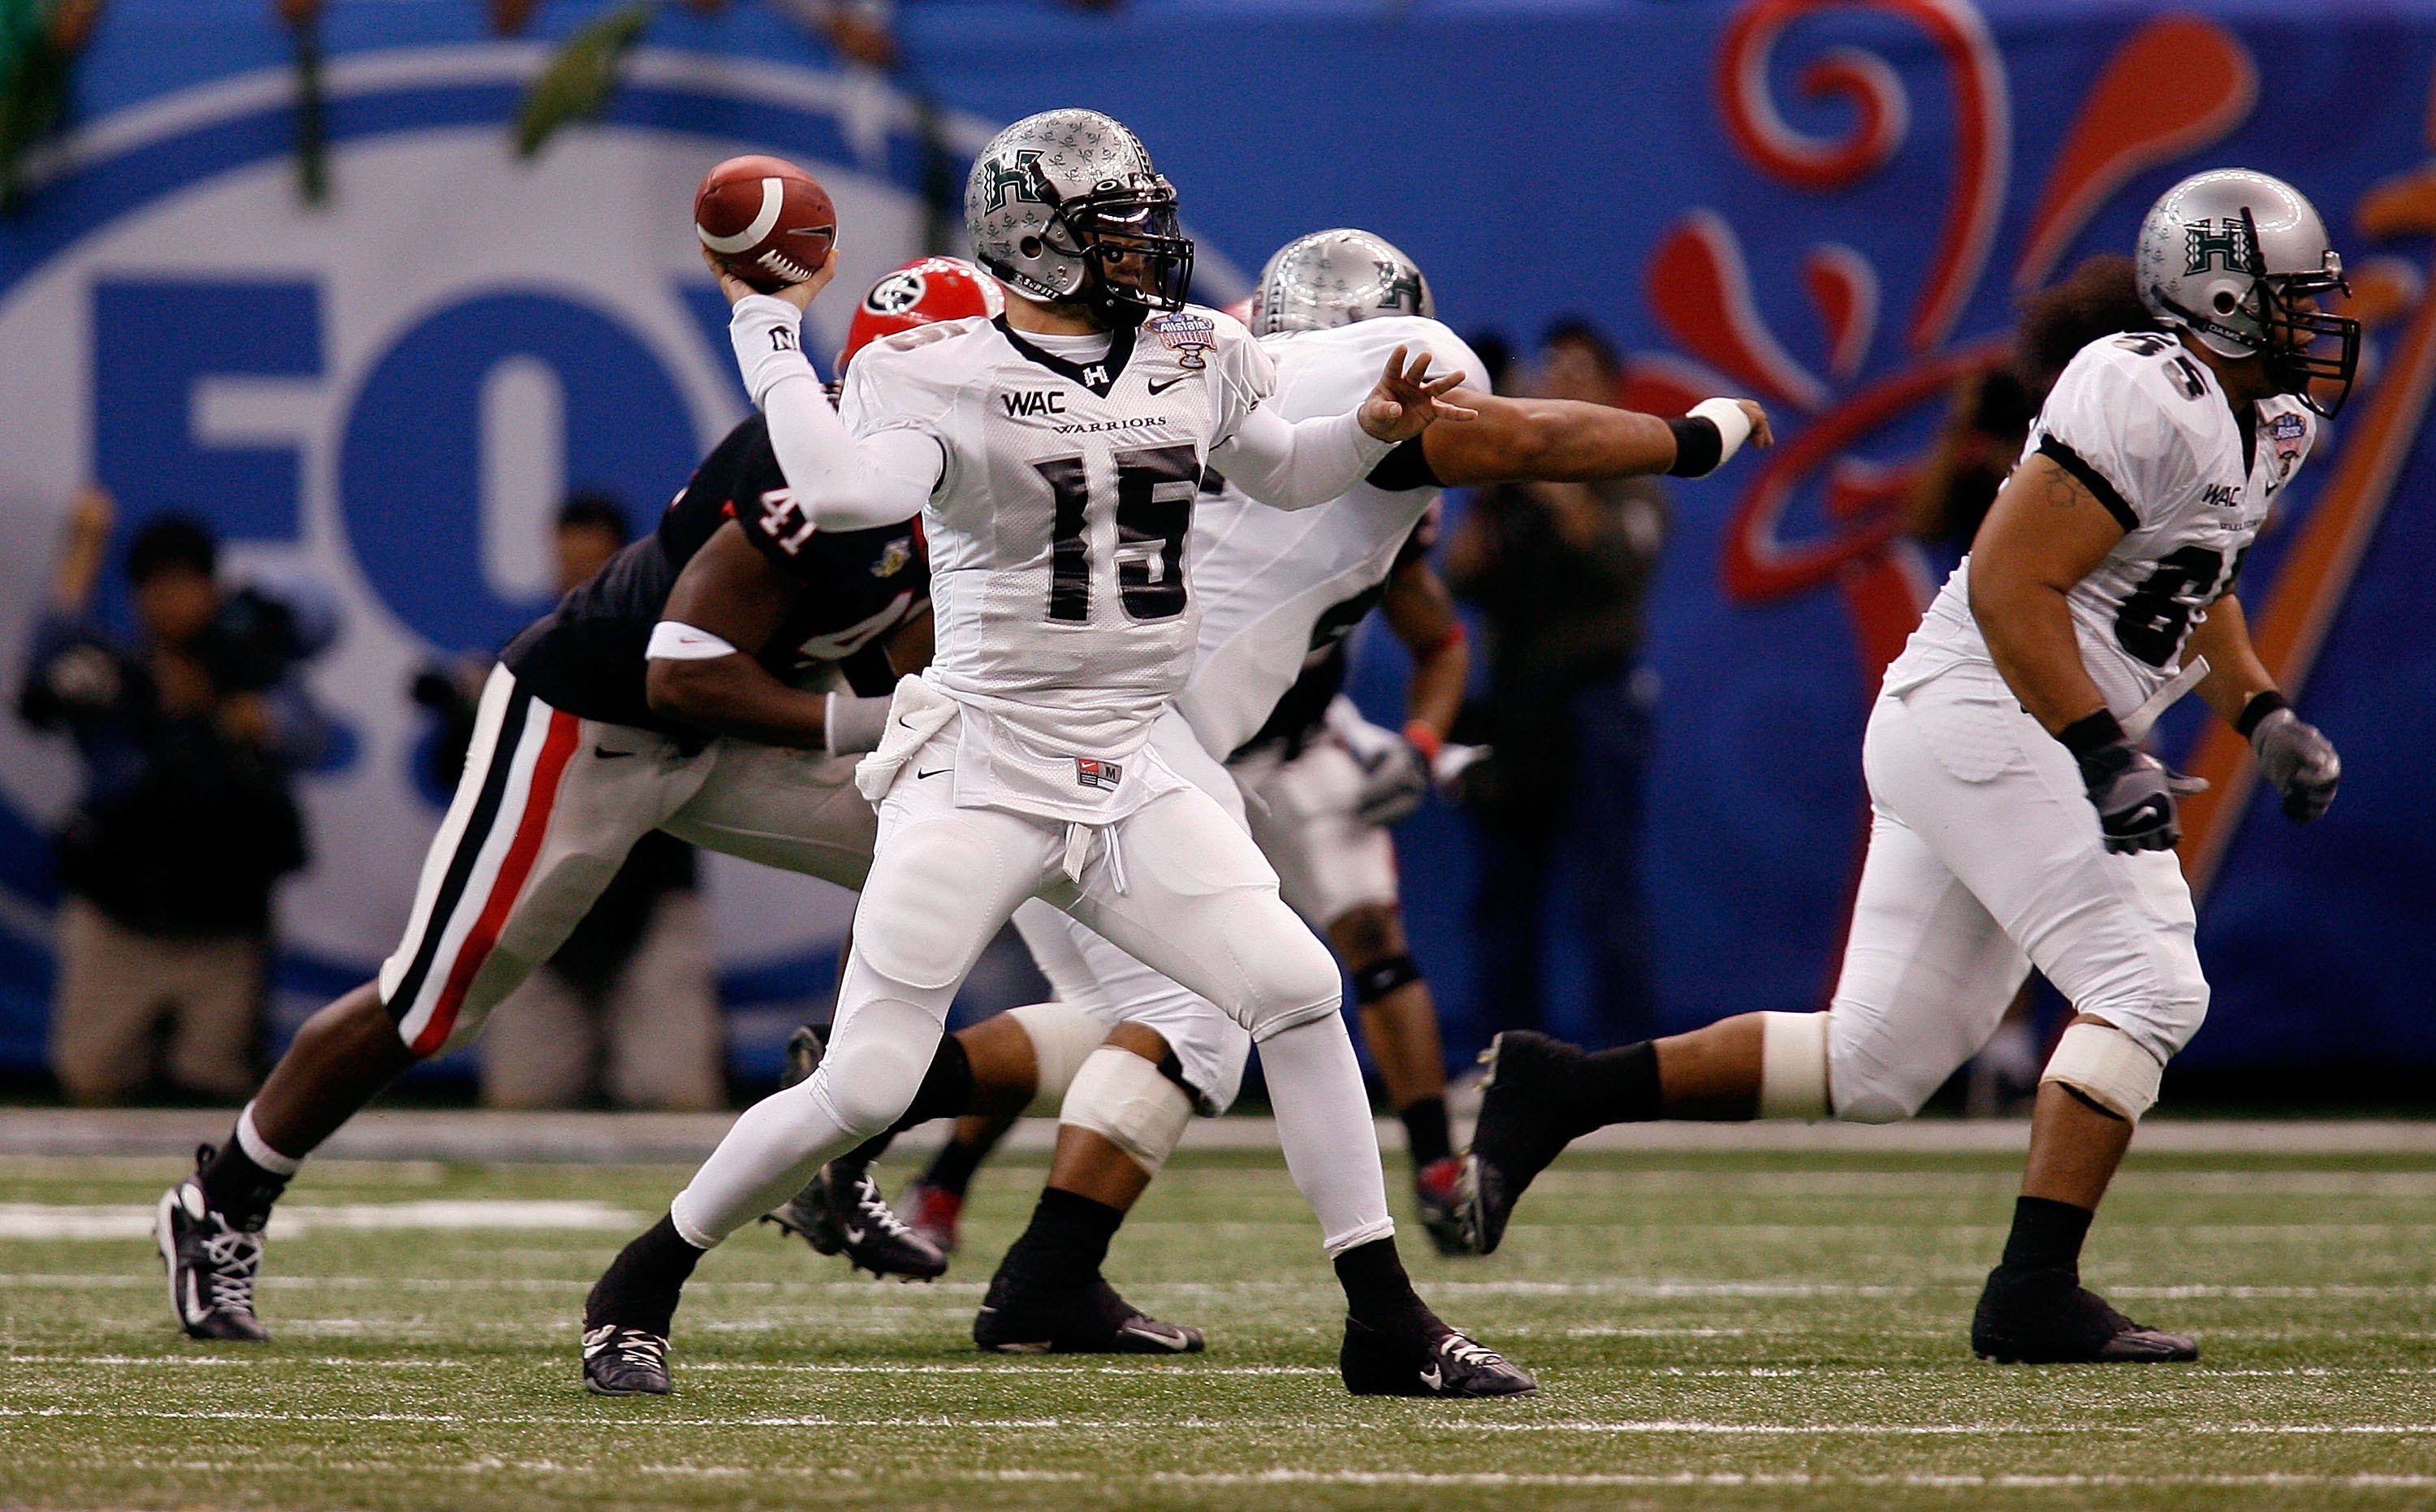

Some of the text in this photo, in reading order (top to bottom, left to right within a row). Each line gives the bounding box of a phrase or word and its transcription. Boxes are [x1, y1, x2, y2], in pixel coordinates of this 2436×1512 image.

[2183, 217, 2251, 276] H
[1160, 320, 1207, 334] Allstate
[1082, 365, 1109, 387] H
[1000, 391, 1065, 417] WAC
[1052, 417, 1167, 434] WARRIORS
[89, 272, 846, 670] FO
[2201, 483, 2241, 507] WAC
[760, 486, 817, 556] 41
[1025, 438, 1202, 626] 15
[1105, 767, 1116, 780] M
